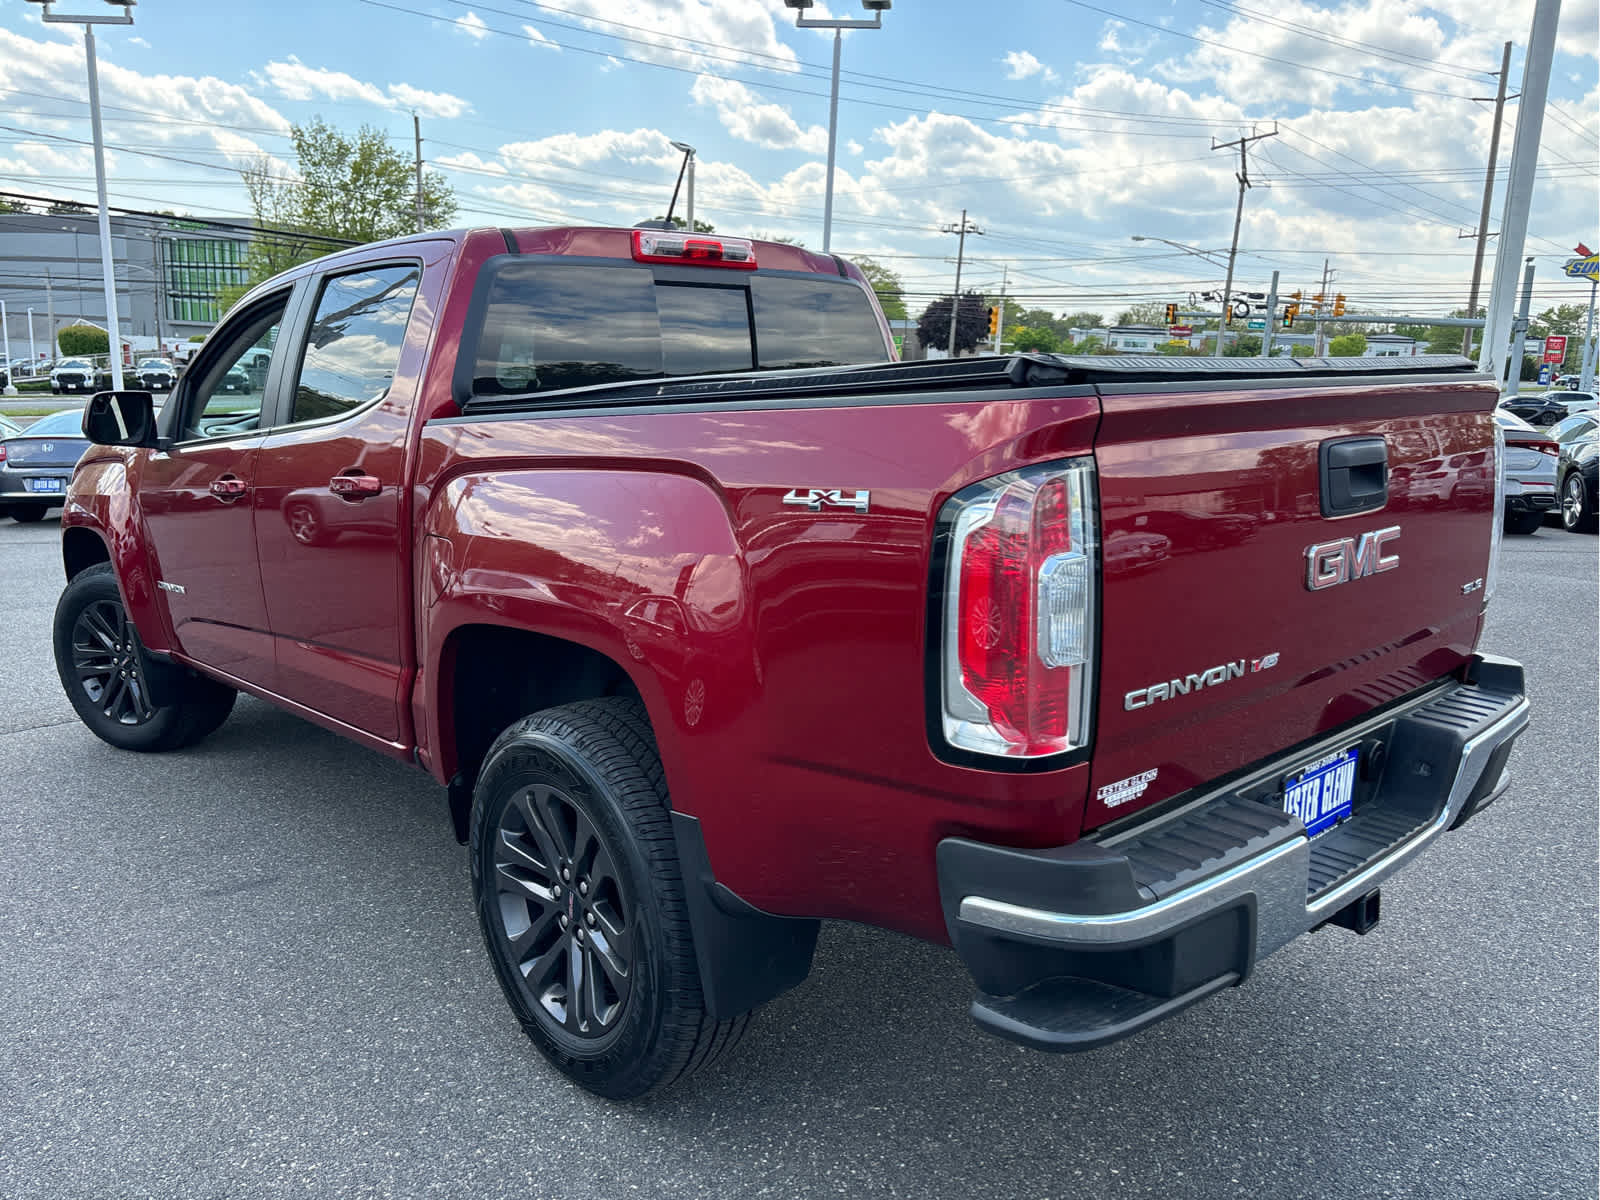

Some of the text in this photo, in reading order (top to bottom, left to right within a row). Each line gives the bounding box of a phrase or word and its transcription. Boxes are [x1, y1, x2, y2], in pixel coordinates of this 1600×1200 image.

[1304, 525, 1400, 591] GMC
[1125, 652, 1280, 711] CANYON V6
[1321, 761, 1356, 814] GLENN
